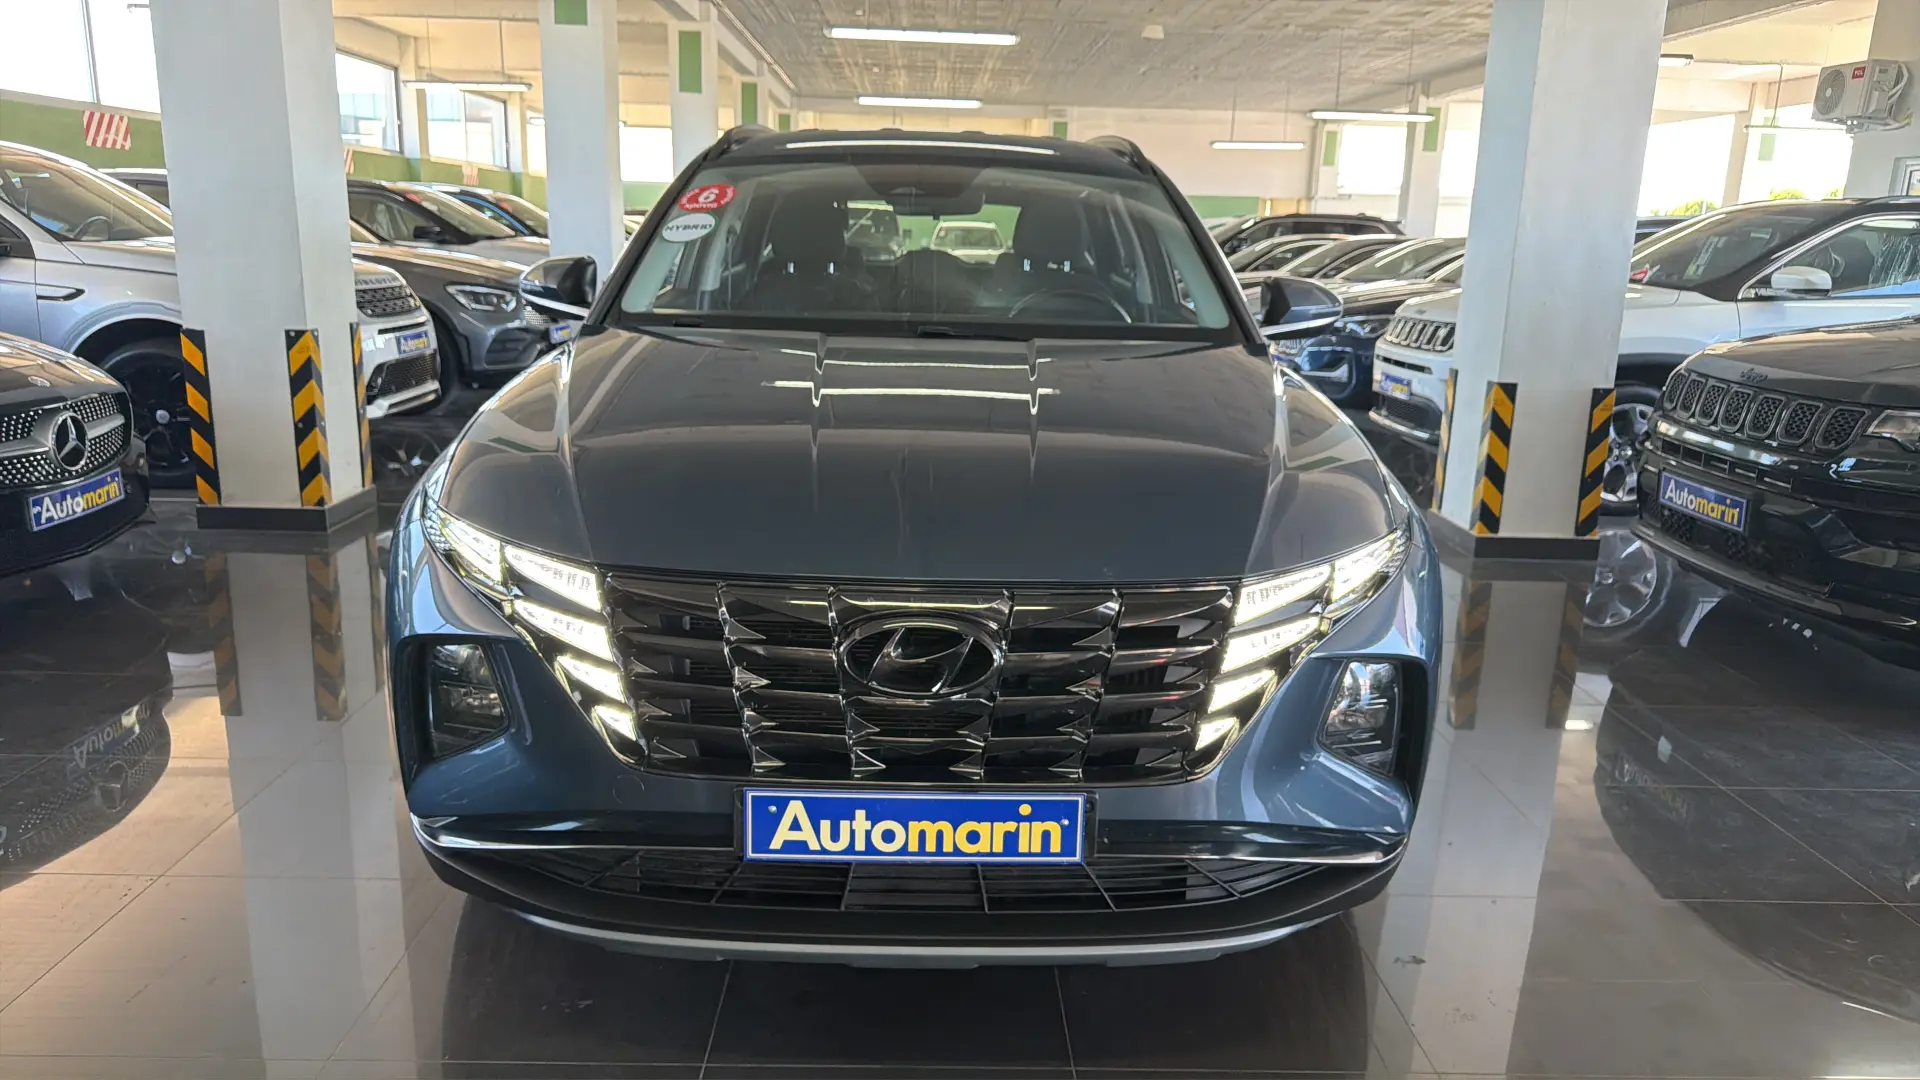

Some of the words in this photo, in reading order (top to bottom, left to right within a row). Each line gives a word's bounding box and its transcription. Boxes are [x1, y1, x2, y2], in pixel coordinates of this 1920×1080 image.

[698, 188, 719, 203] 6
[664, 223, 713, 232] HYBRID
[40, 475, 120, 524] Automarin
[1664, 478, 1739, 525] Automarin
[769, 799, 1062, 854] Automarin
